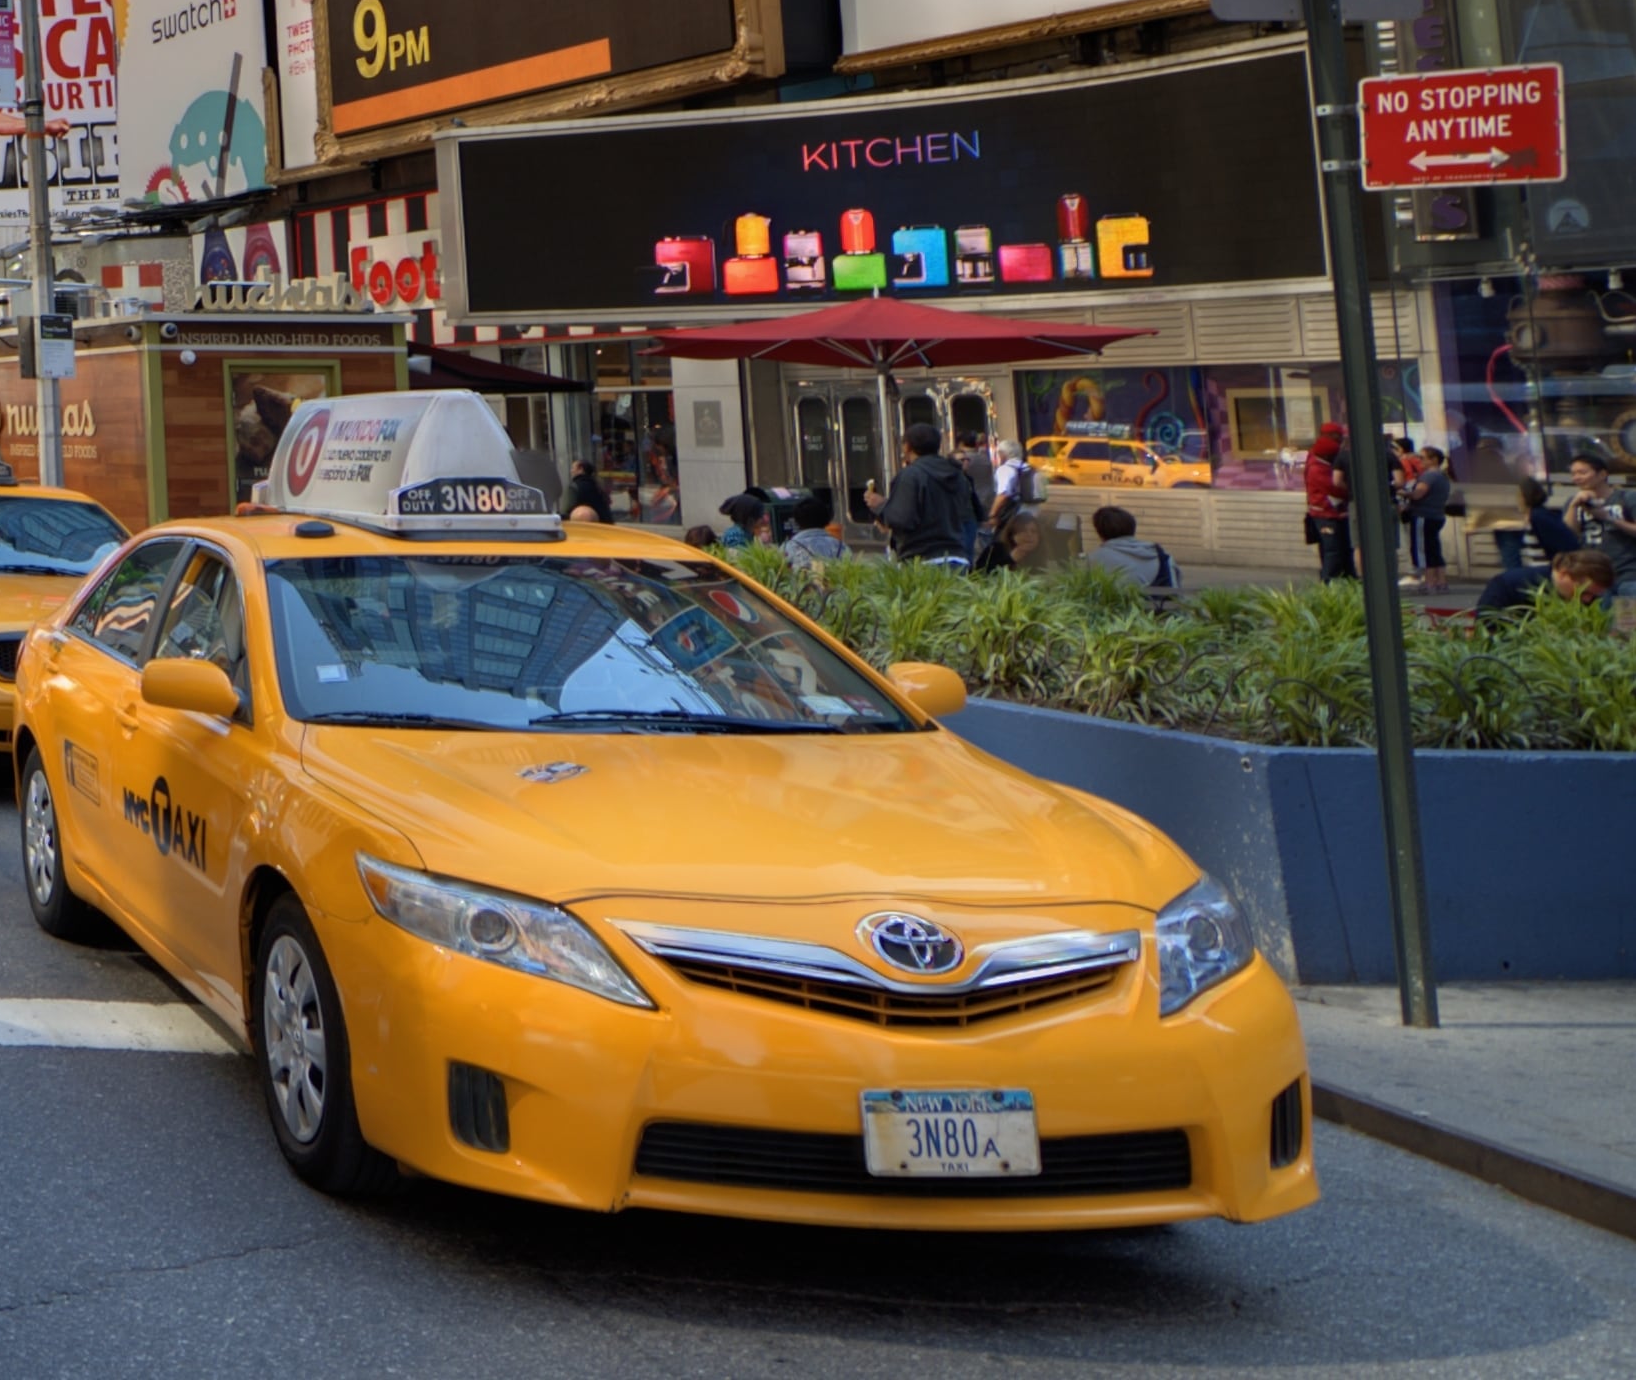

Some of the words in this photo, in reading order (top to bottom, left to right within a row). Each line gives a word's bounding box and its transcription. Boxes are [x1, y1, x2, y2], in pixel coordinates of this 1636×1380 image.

[1377, 92, 1409, 114] NO
[1419, 81, 1542, 112] STOPPING
[1406, 114, 1512, 142] ANYTIME
[802, 130, 981, 172] KITCHEN
[66, 189, 102, 202] THE
[351, 240, 441, 306] Foot
[177, 333, 240, 346] INSPIRED
[243, 333, 330, 346] HAND-HELD
[332, 333, 381, 346] FOODS
[402, 500, 436, 511] DUTY
[407, 489, 431, 499] OFF
[441, 485, 506, 512] 3N80
[905, 1094, 942, 1112] NEW
[945, 1094, 992, 1113] YORK
[940, 1162, 970, 1172] TAXI
